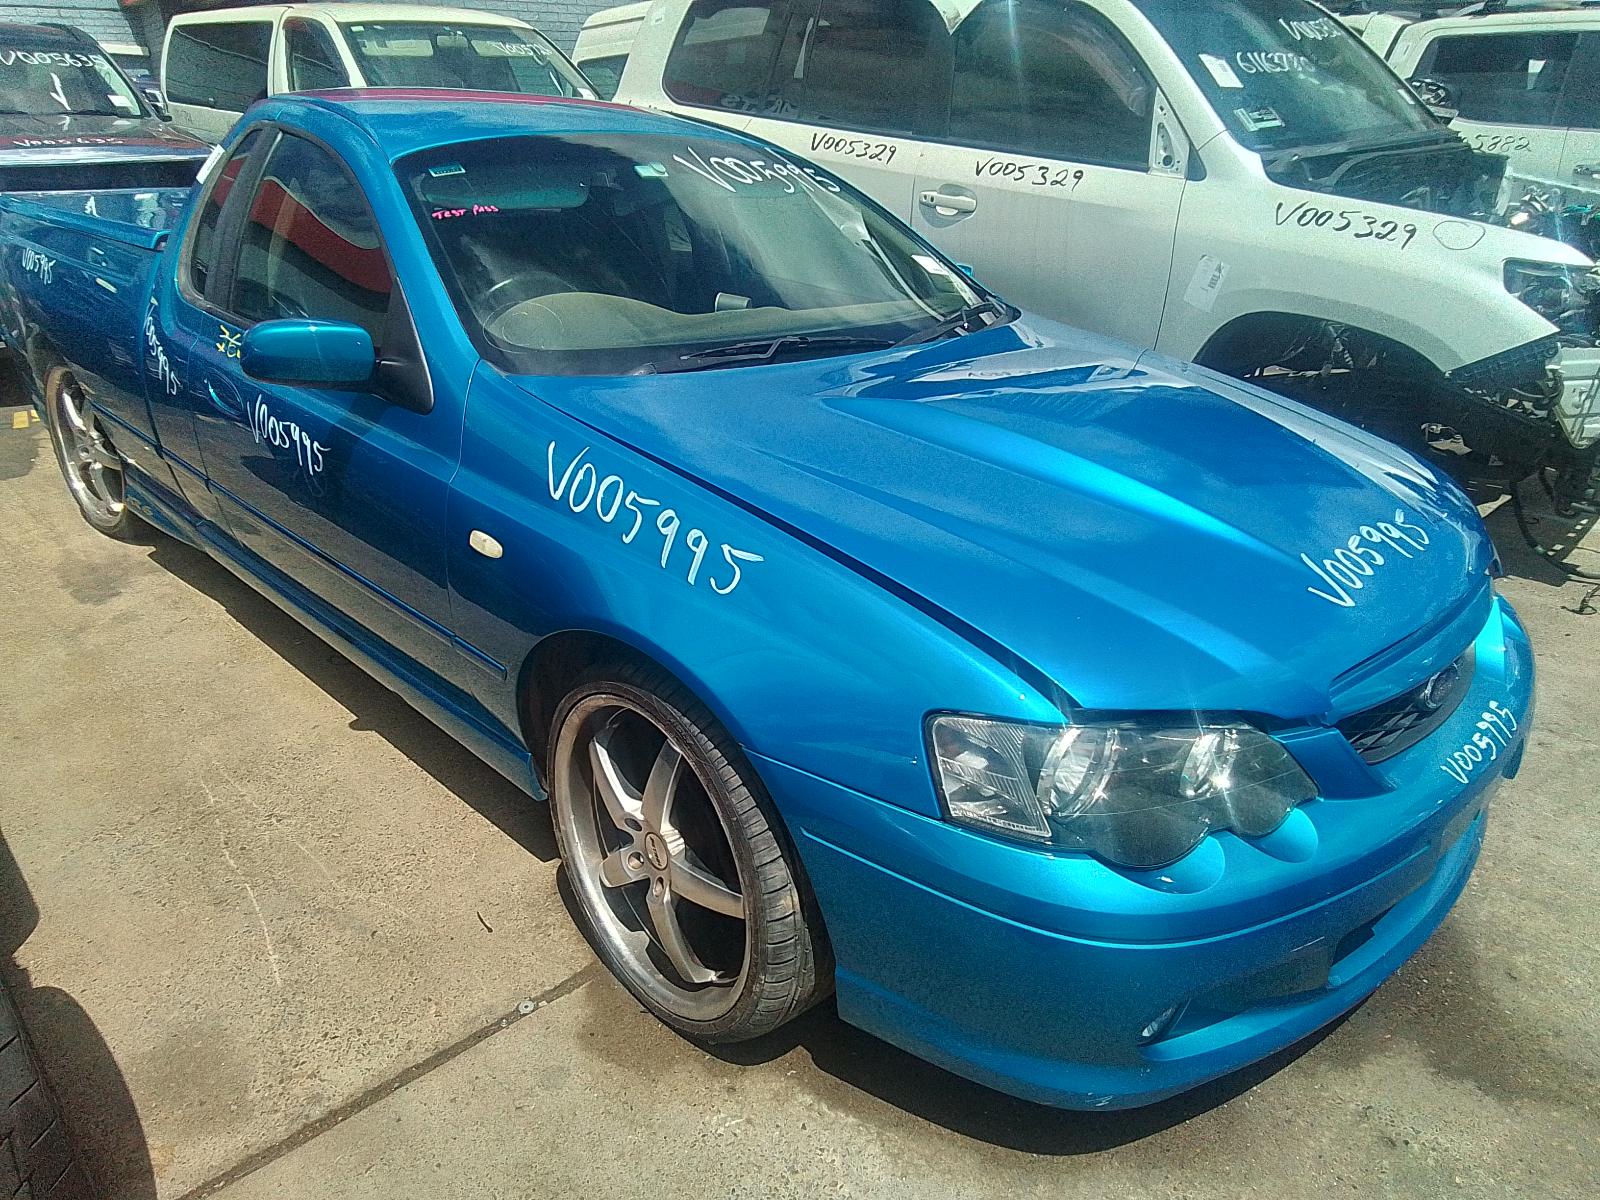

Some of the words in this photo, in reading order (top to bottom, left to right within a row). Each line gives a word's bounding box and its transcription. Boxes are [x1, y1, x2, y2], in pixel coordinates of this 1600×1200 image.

[811, 131, 898, 165] V005329
[1463, 134, 1532, 153] 5882
[672, 145, 841, 194] V005995
[976, 158, 1085, 192] V005329
[1275, 201, 1417, 250] V005329
[22, 247, 57, 286] V005995
[248, 394, 331, 477] V005995
[547, 440, 765, 595] V005995
[1301, 508, 1430, 607] V005995
[1440, 701, 1517, 784] V005995
